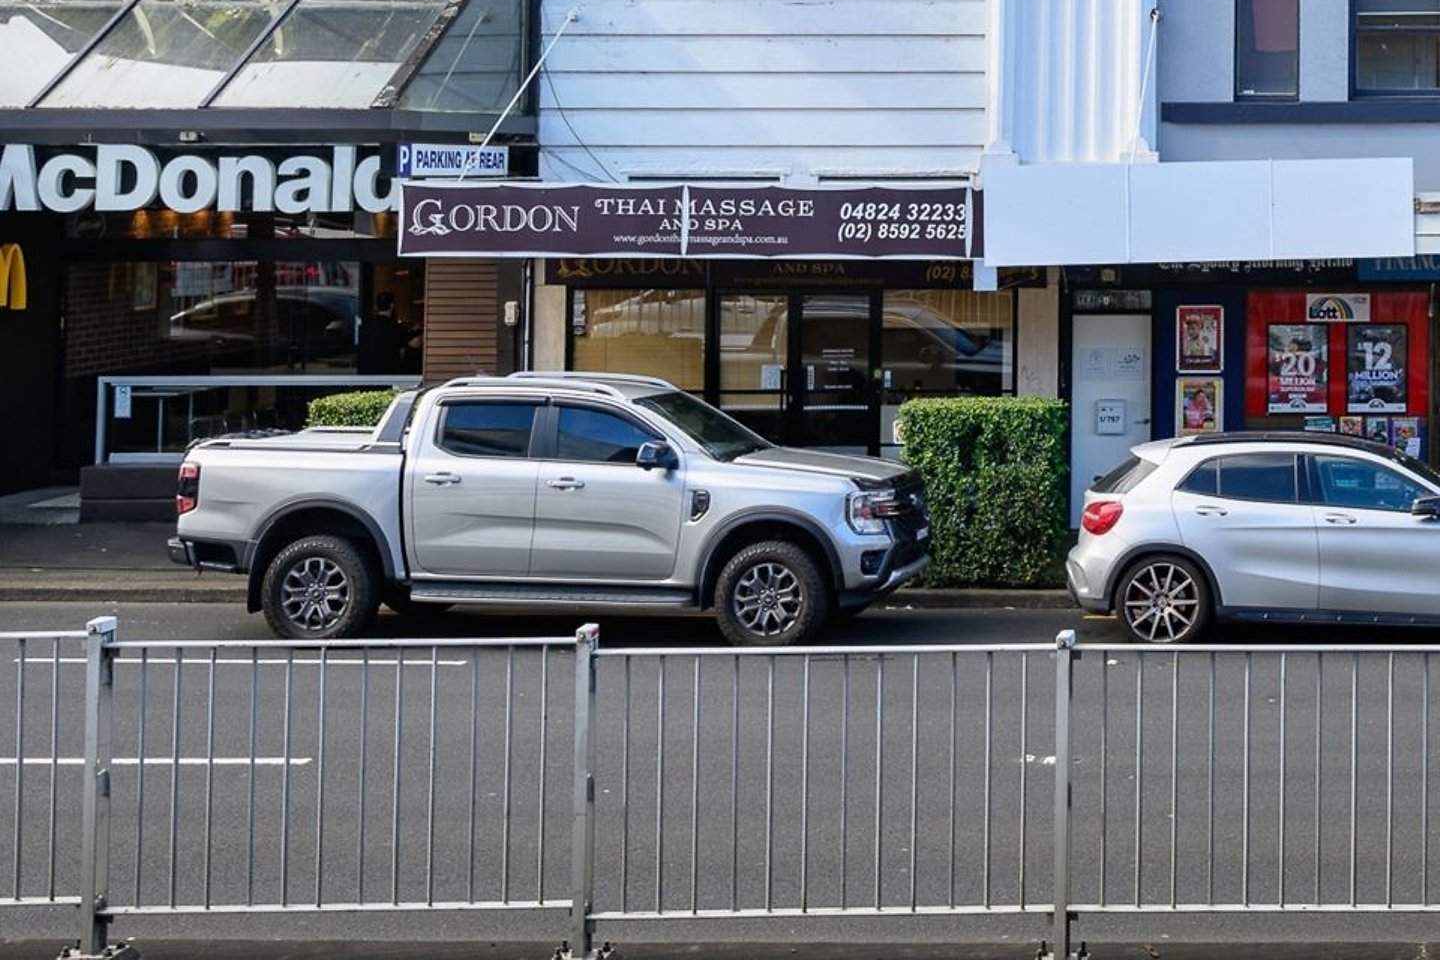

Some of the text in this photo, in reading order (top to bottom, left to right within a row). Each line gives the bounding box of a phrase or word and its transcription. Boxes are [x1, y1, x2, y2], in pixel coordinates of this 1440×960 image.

[416, 150, 462, 169] PARKING
[479, 152, 505, 169] REAR
[408, 198, 815, 236] GORDON THAI MASSAGE
[840, 203, 967, 221] 04824 32233
[704, 219, 743, 230] SPA
[838, 222, 967, 242] (02) 8592 5625
